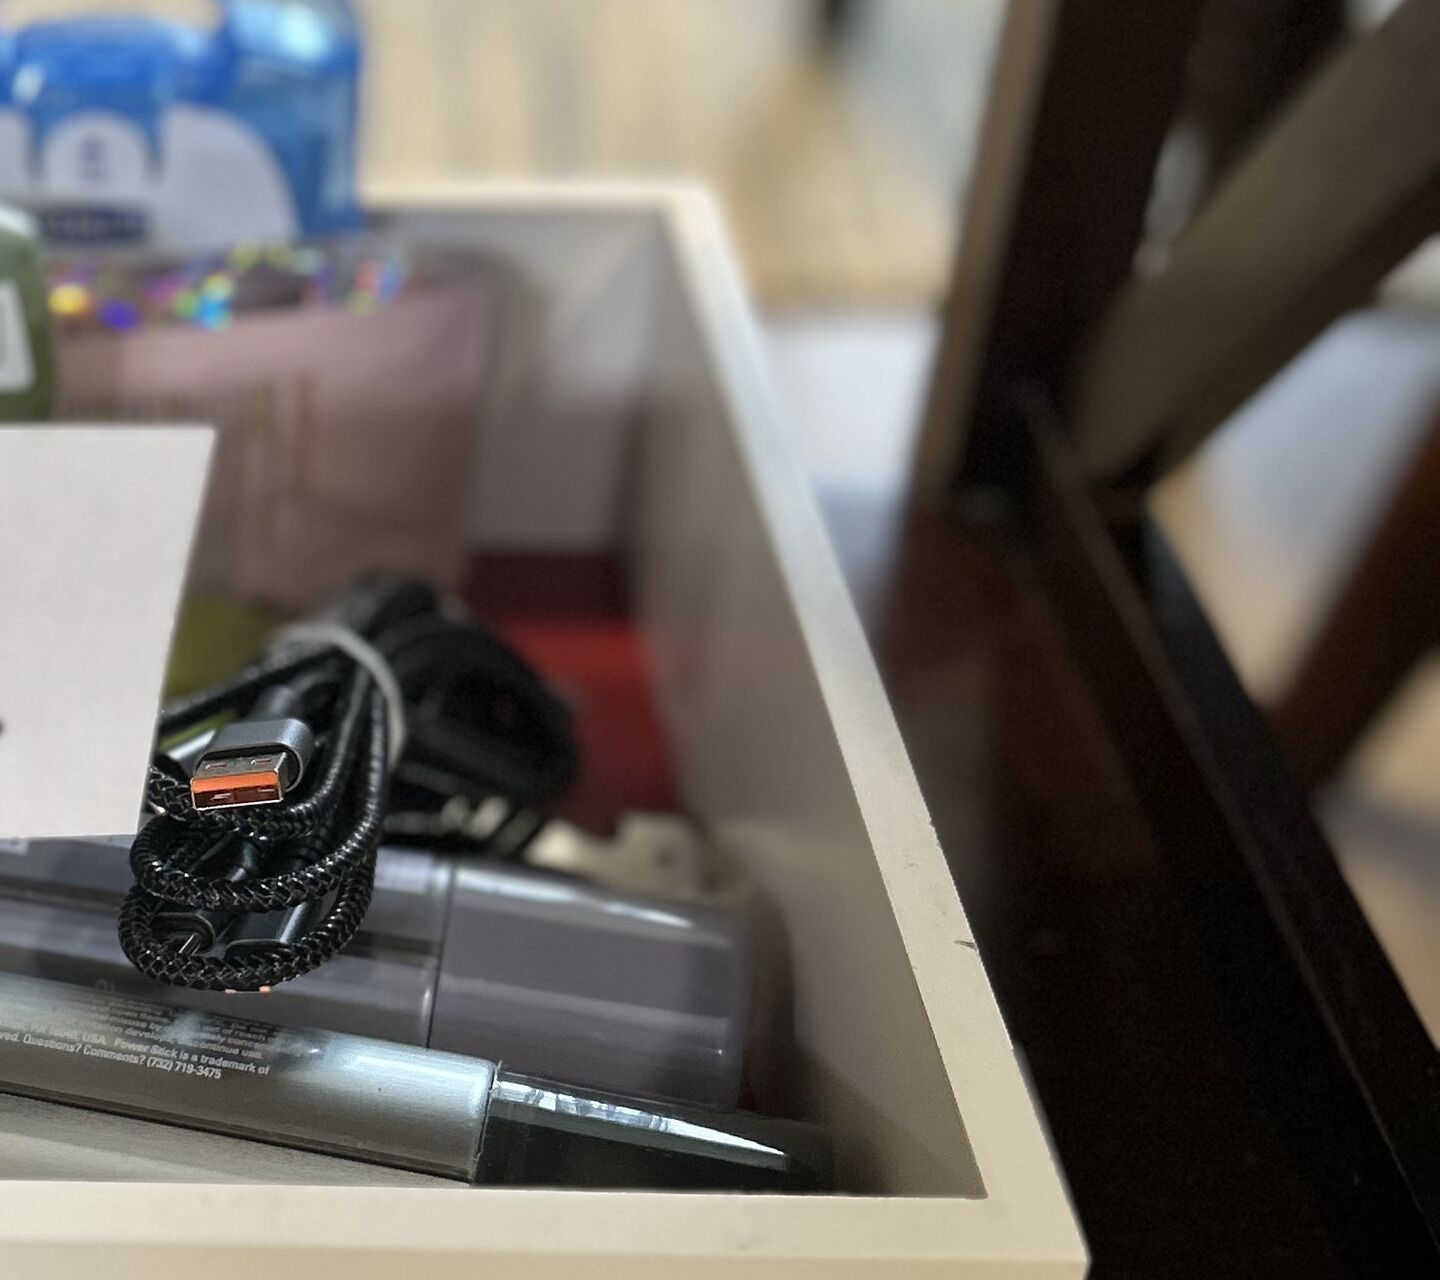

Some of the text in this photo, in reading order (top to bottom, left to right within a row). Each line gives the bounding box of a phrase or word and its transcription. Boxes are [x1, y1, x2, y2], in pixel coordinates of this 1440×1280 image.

[21, 1032, 83, 1055] Questions?
[81, 1043, 147, 1067] Comments?
[145, 1055, 174, 1073] (732)
[173, 1060, 222, 1081] 719-3475
[112, 1037, 150, 1054] Power
[149, 1044, 178, 1059] Stick
[177, 1050, 190, 1061] is
[189, 1054, 199, 1063] a
[198, 1053, 257, 1074] trademark
[256, 1064, 271, 1076] of
